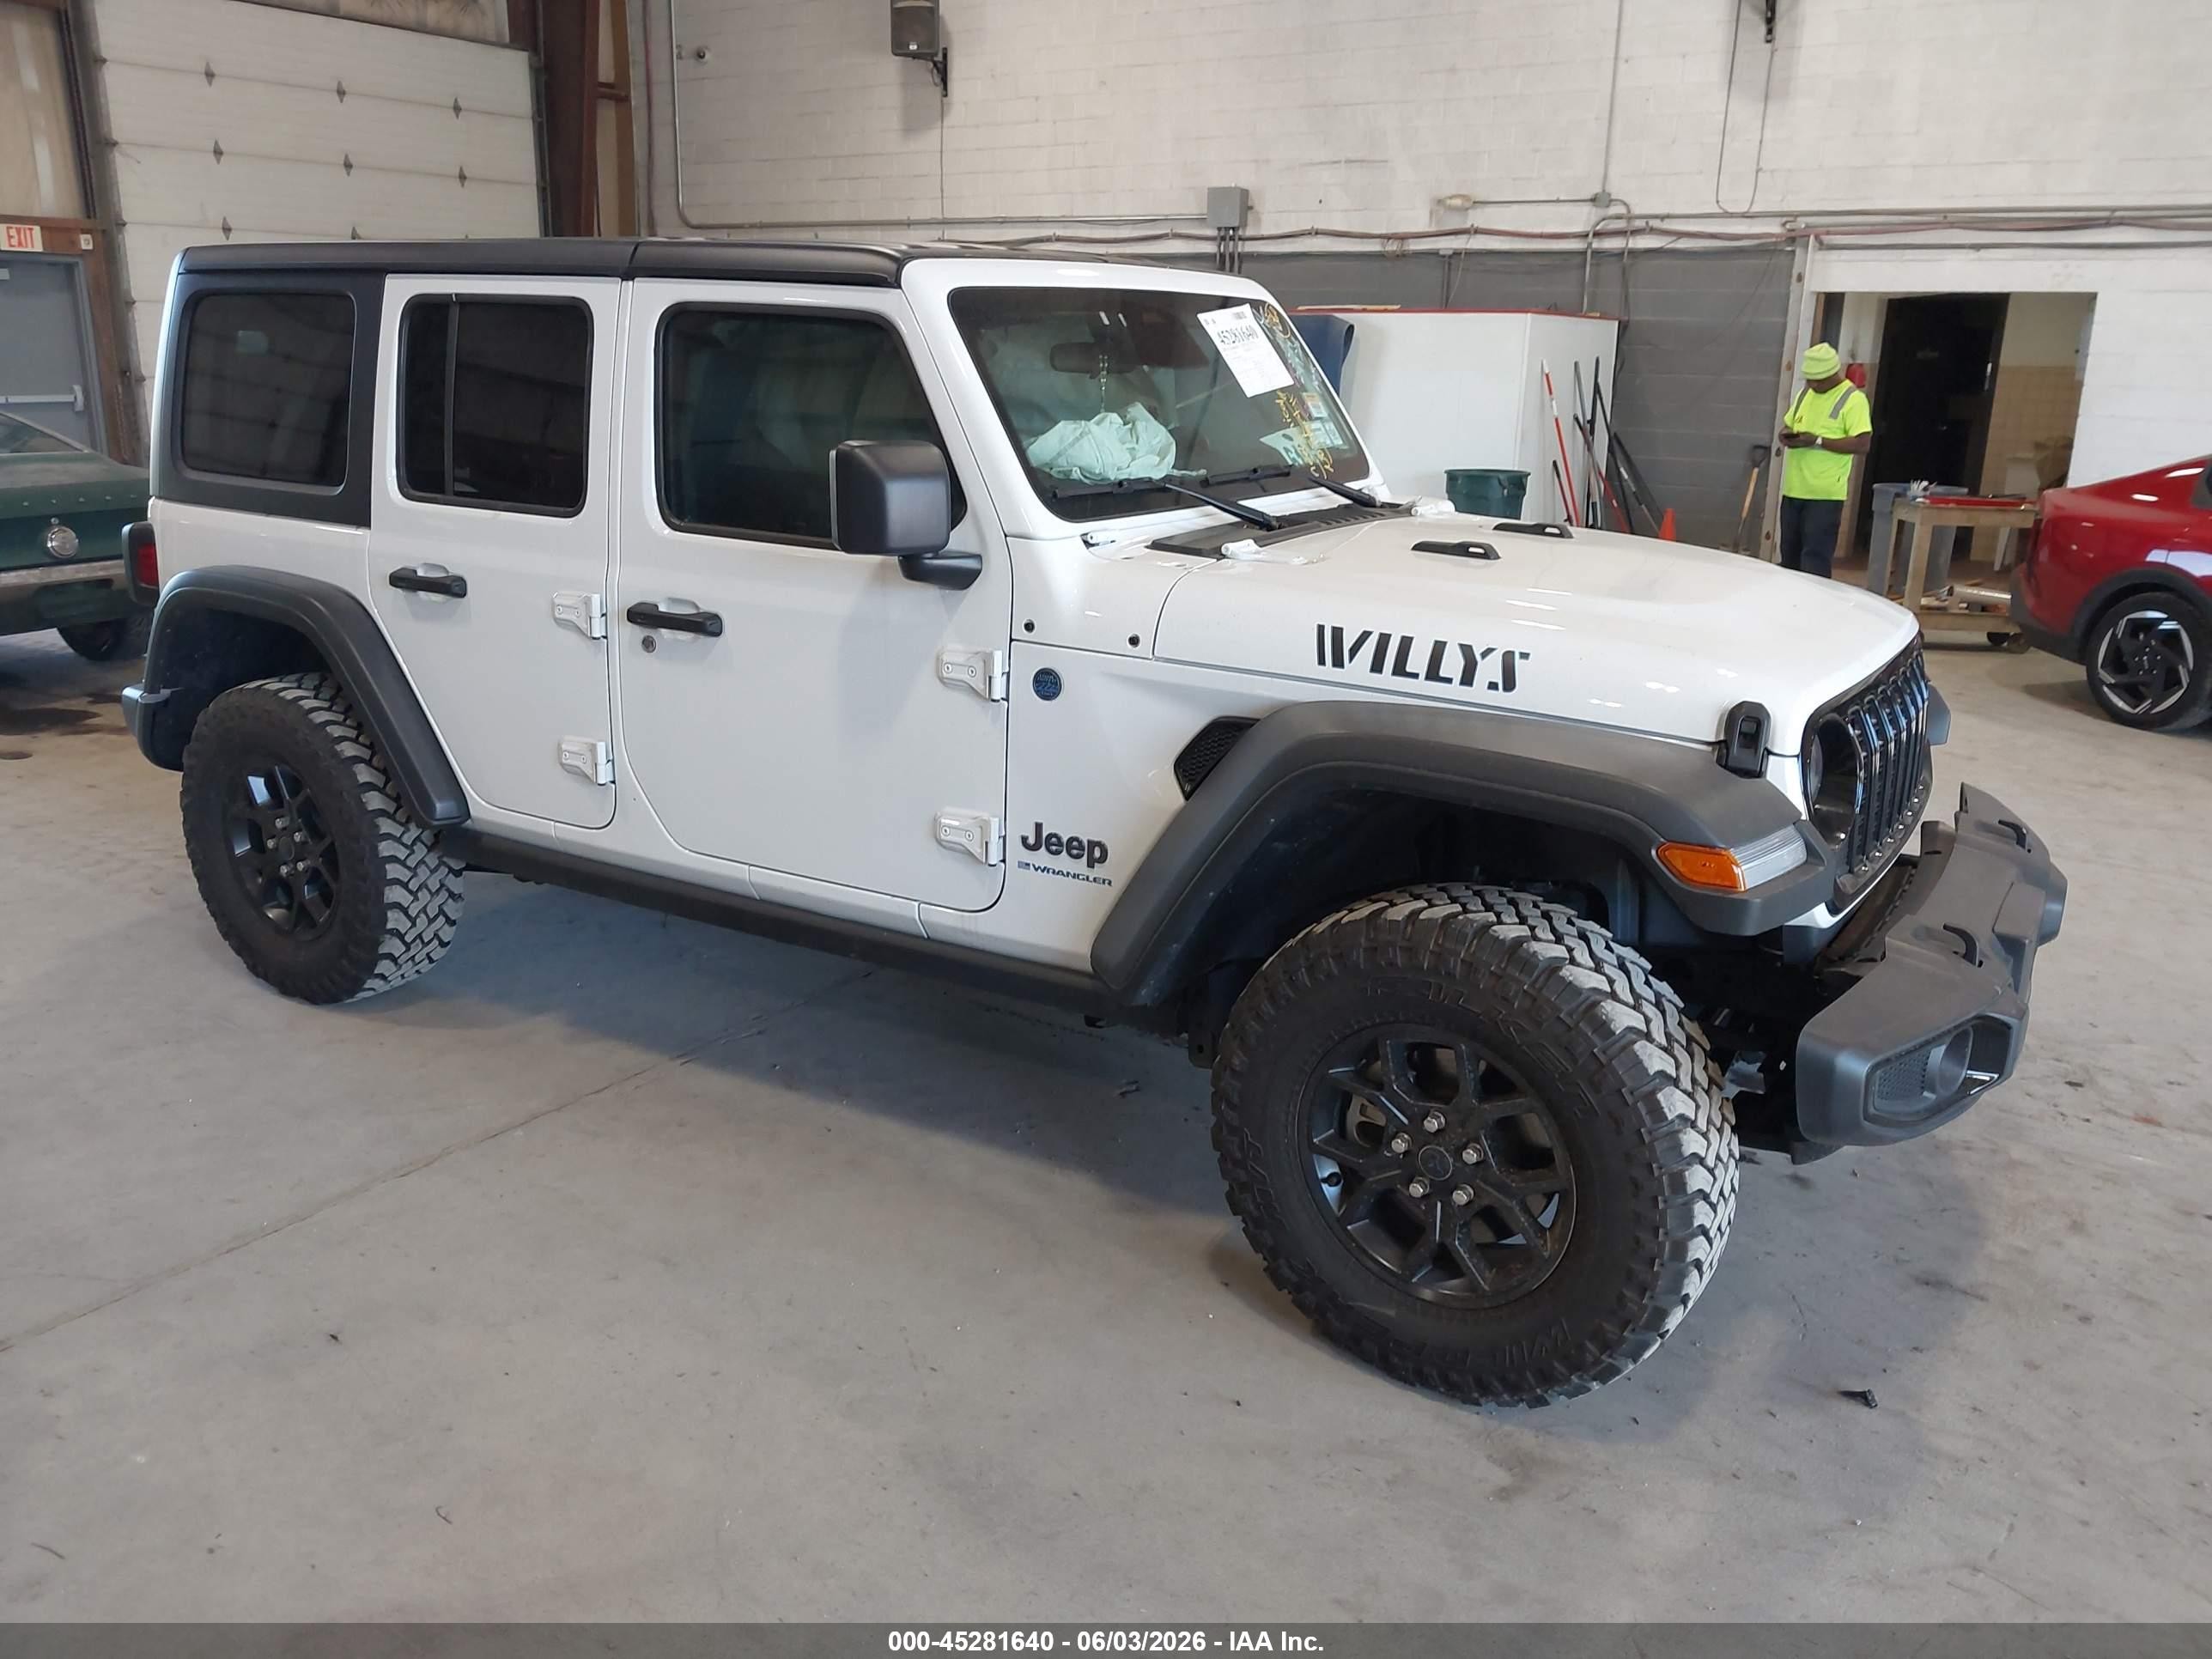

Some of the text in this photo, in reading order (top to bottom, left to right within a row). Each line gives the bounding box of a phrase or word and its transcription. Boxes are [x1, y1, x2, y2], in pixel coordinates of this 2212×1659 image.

[6, 226, 34, 247] EXIT
[1316, 623, 1531, 693] WILLYS
[1021, 822, 1108, 869] Jeep
[1032, 862, 1113, 887] WRANGLER
